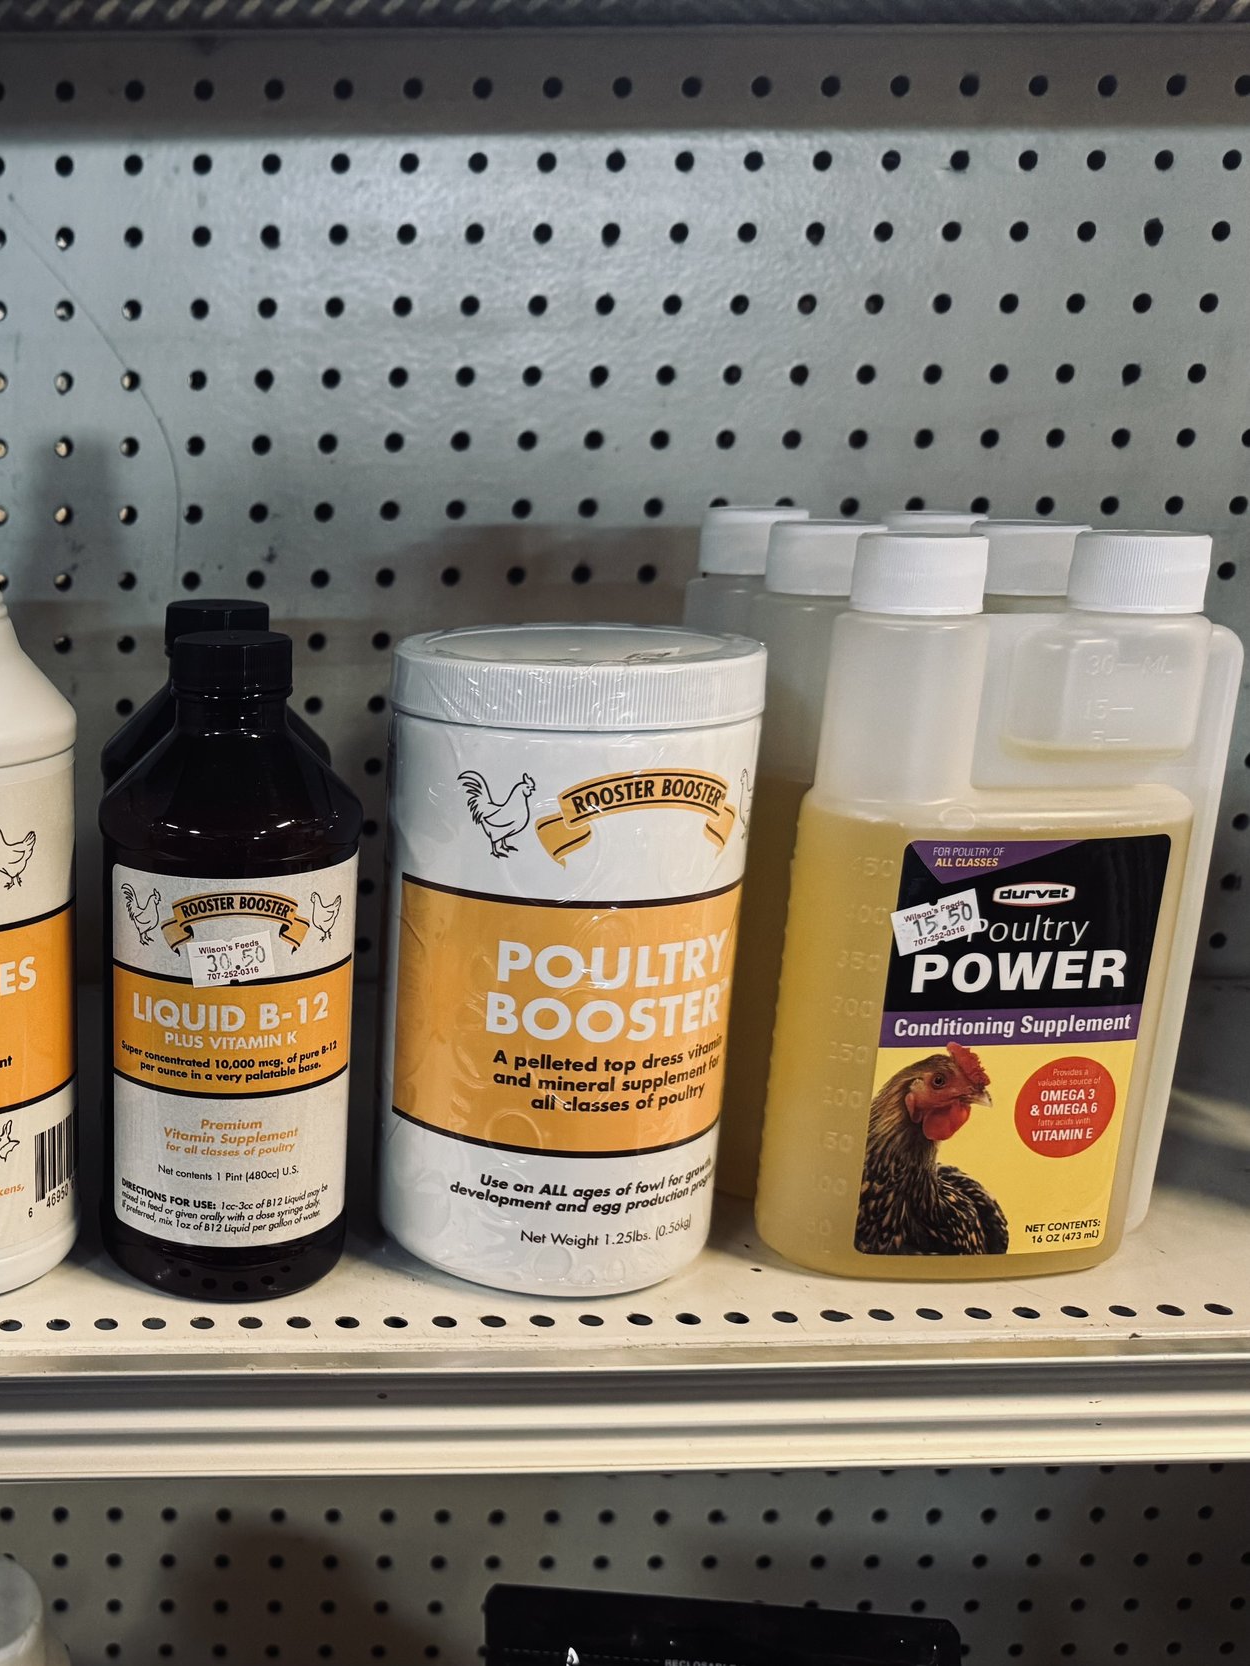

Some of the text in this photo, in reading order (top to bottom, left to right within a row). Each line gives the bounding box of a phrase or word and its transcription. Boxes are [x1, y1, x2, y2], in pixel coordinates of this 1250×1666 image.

[571, 778, 722, 815] ROOSTER BOOSTER
[933, 847, 1005, 856] FOR POULTRY OF
[935, 858, 999, 867] ALL CLASSES
[998, 887, 1069, 899] durvet
[181, 896, 289, 918] ROOSTER BOOSTER
[904, 909, 938, 922] Wilson's
[940, 900, 965, 912] Feeds
[913, 903, 972, 936] 15.50
[914, 926, 965, 946] 707-252-0316
[199, 940, 259, 954] Wilson's Feeds
[207, 945, 265, 972] 30.50
[497, 929, 728, 991] POULTRY
[207, 966, 259, 980] 707-252-0316
[910, 949, 1127, 993] POWER
[133, 992, 328, 1032] LIQUID B-12
[485, 984, 719, 1043] BOOSTER
[894, 1013, 1131, 1038] Conditioning Supplement
[165, 1031, 297, 1050] PLUS VITAMIN K
[493, 1050, 508, 1063] A
[514, 1054, 597, 1071] pelleted
[604, 1059, 636, 1075] top
[641, 1053, 683, 1069] dress
[493, 1055, 719, 1092] and mineral supplement for
[1041, 1089, 1095, 1101] OMEGA 3
[1030, 1103, 1097, 1116] & OMEGA 6
[200, 1120, 262, 1130] Premium
[1032, 1128, 1093, 1141] VITAMIN E
[164, 1127, 299, 1146] Vitamin Supplement
[166, 1143, 295, 1159] for all classes of poultry
[29, 1208, 33, 1217] 6
[1025, 1219, 1101, 1233] NET CONTENTS:
[521, 1229, 547, 1243] Net
[551, 1233, 599, 1248] Weight
[604, 1232, 651, 1246] 1.25lbs.
[1032, 1229, 1099, 1244] 16 OZ (473 mL)
